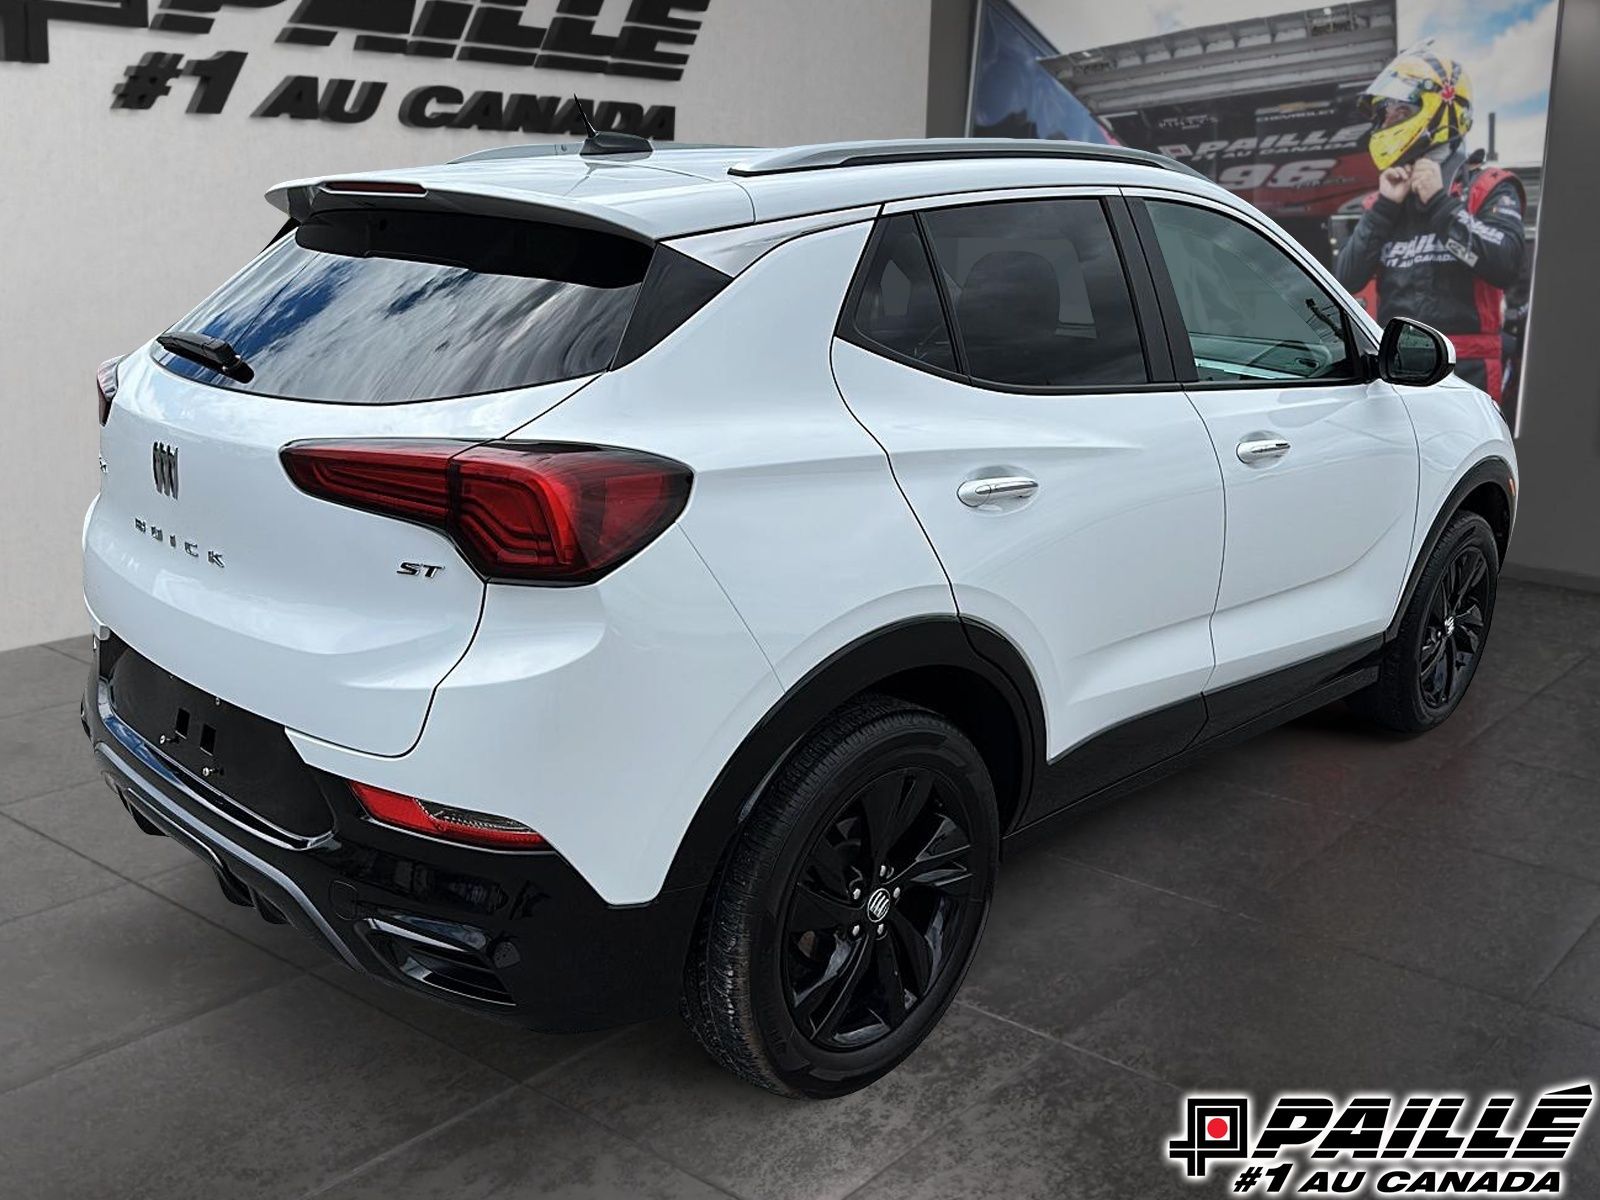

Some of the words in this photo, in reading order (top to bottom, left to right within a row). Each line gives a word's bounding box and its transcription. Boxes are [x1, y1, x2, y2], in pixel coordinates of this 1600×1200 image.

[110, 51, 249, 115] #1
[249, 75, 388, 123] AU
[398, 85, 676, 141] CANADA
[1259, 141, 1357, 156] CANADA
[1218, 158, 1337, 191] 96
[134, 516, 226, 569] BUICK
[396, 561, 443, 579] ST
